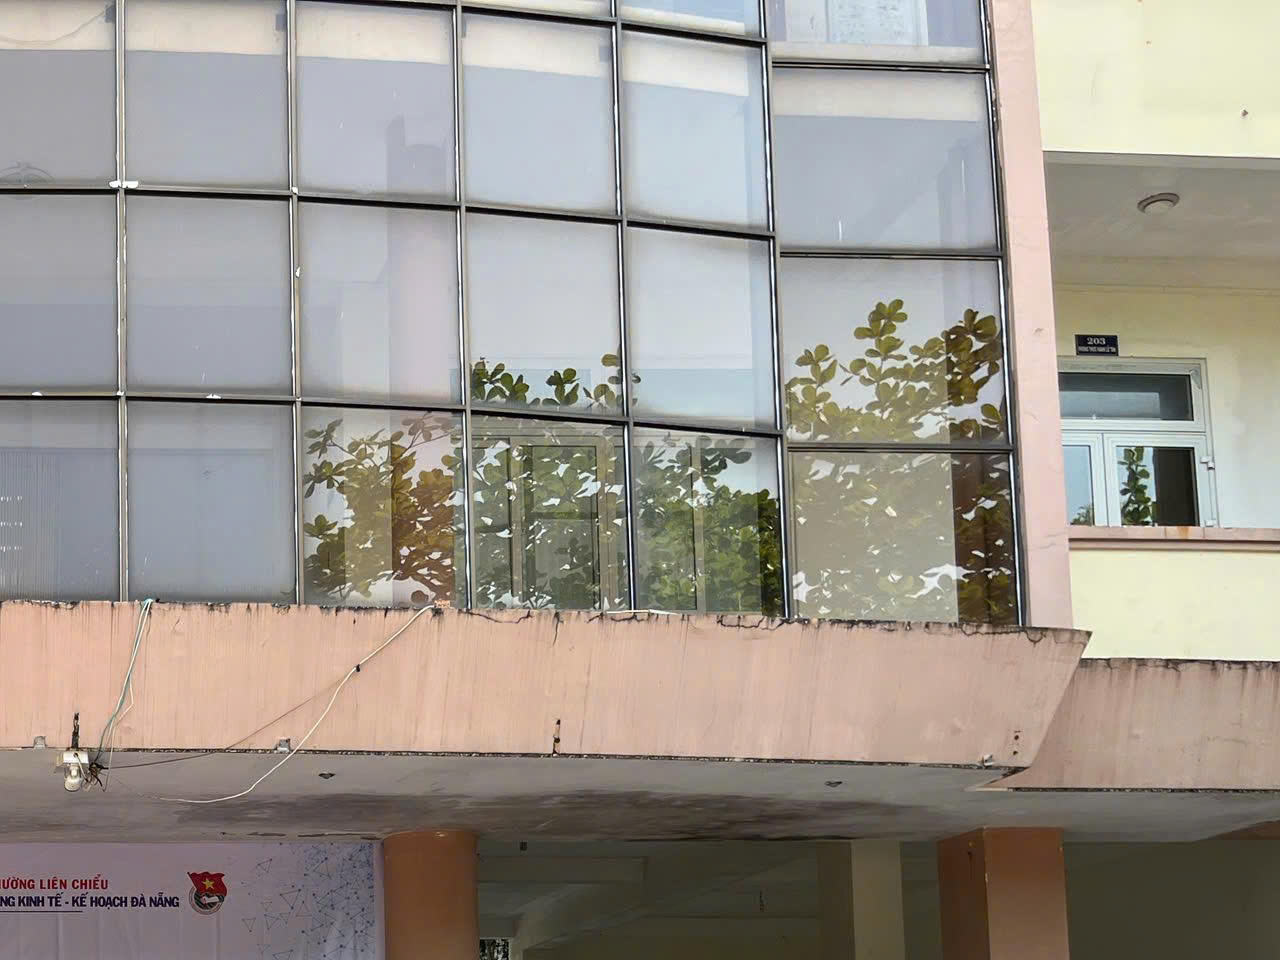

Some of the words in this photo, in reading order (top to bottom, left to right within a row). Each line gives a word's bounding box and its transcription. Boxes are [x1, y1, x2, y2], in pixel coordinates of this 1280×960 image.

[1087, 337, 1106, 345] 203
[40, 877, 67, 889] LIÊN
[72, 874, 108, 889] CHIỂU
[18, 896, 44, 907] KINH
[47, 892, 63, 906] TẾ
[72, 892, 88, 907] KẾ
[90, 896, 127, 909] HOẠCH
[131, 894, 146, 907] ĐÀ
[149, 892, 179, 907] NẴNG
